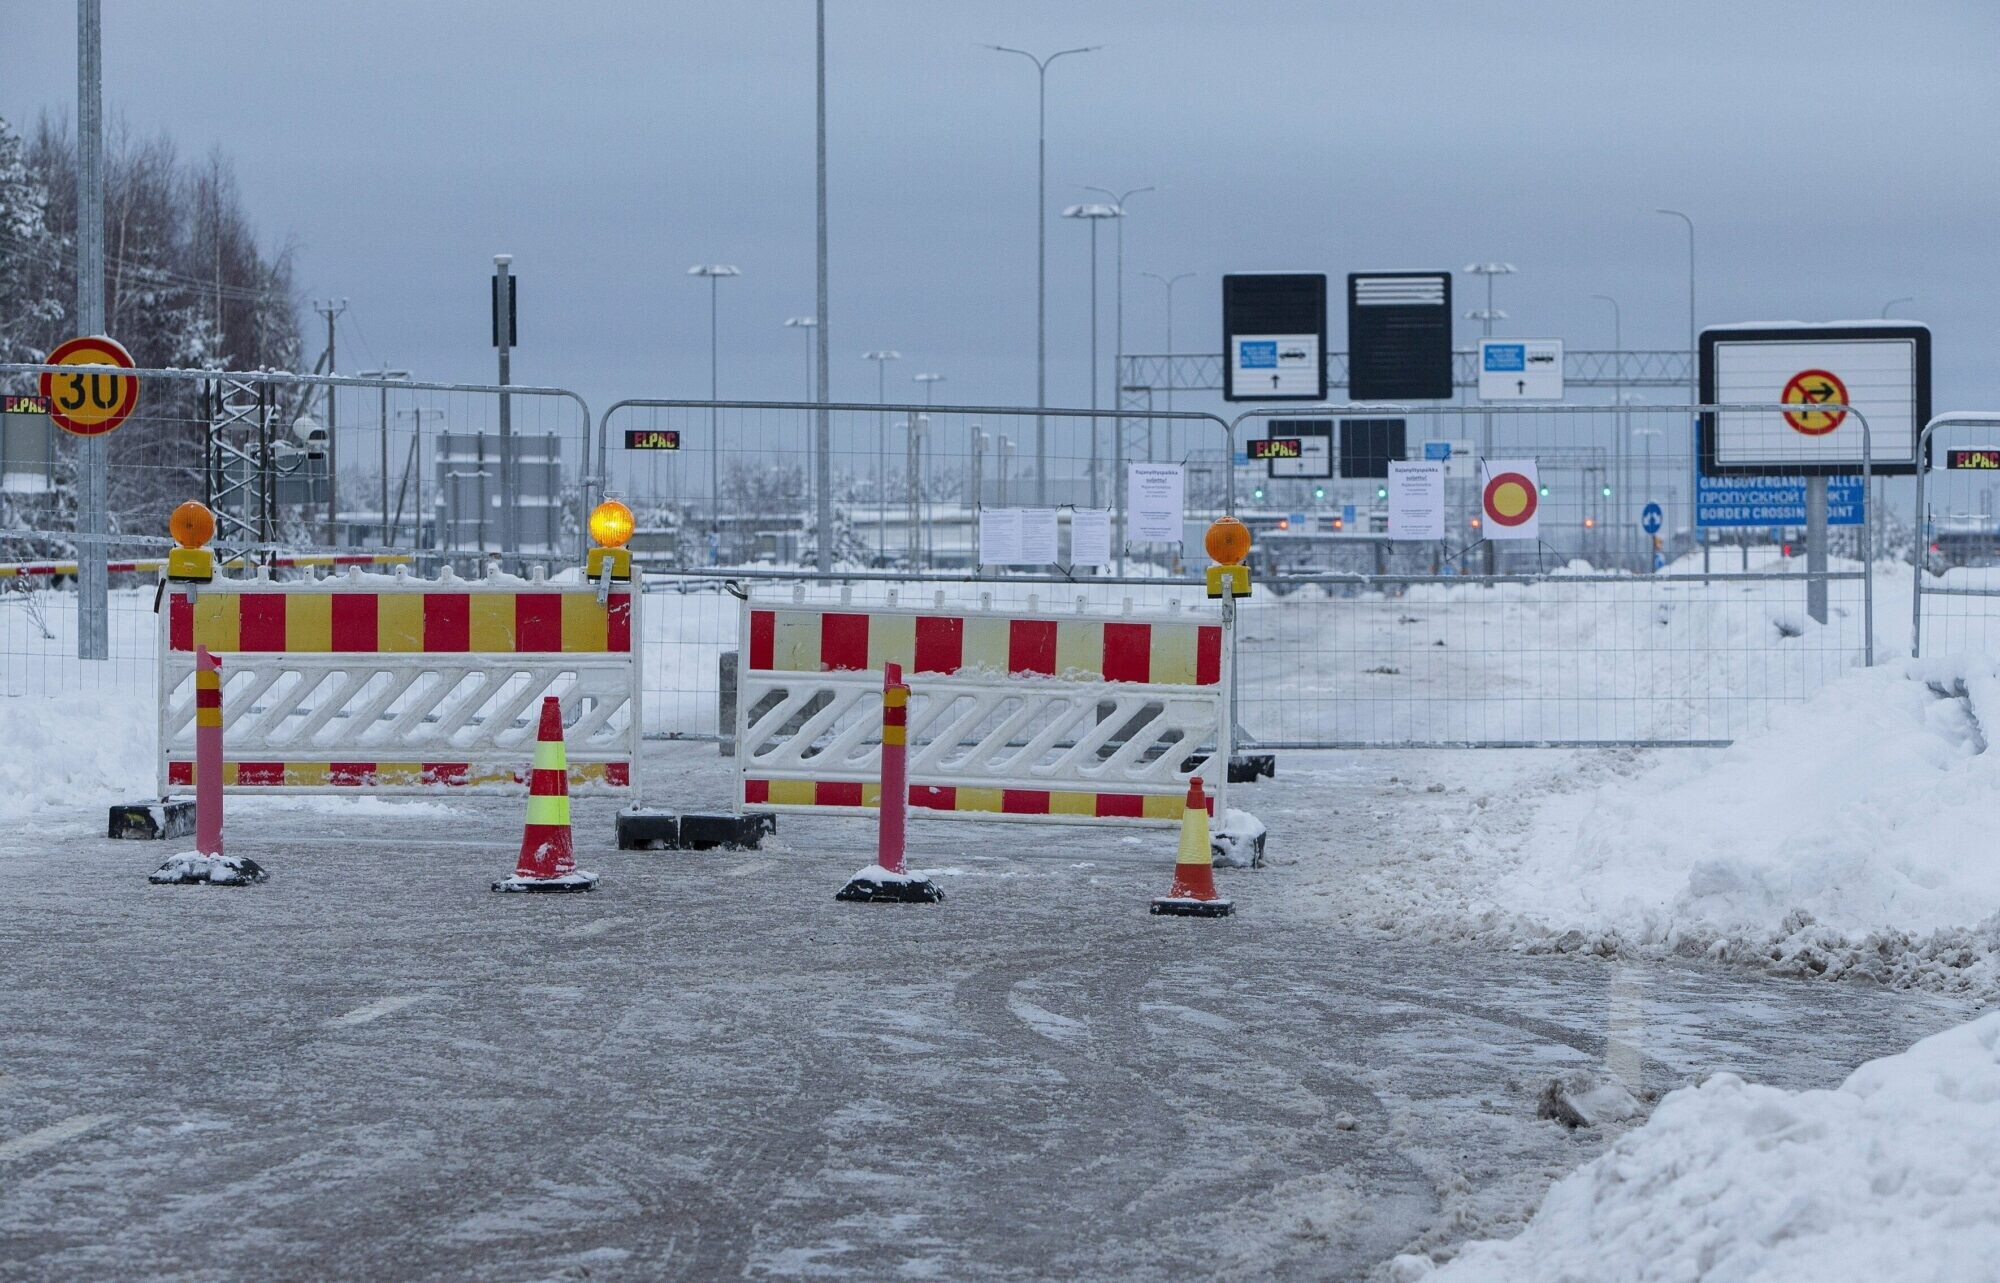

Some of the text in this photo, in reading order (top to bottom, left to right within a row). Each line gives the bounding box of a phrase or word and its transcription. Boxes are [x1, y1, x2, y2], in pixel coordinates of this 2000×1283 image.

[60, 363, 118, 410] 30
[5, 396, 46, 413] ELPAC
[634, 431, 675, 448] ELPAC
[1256, 440, 1297, 457] ELPAC
[1957, 451, 1998, 468] ELPAC
[1700, 506, 1854, 520] BORDER CROSSIN OINT
